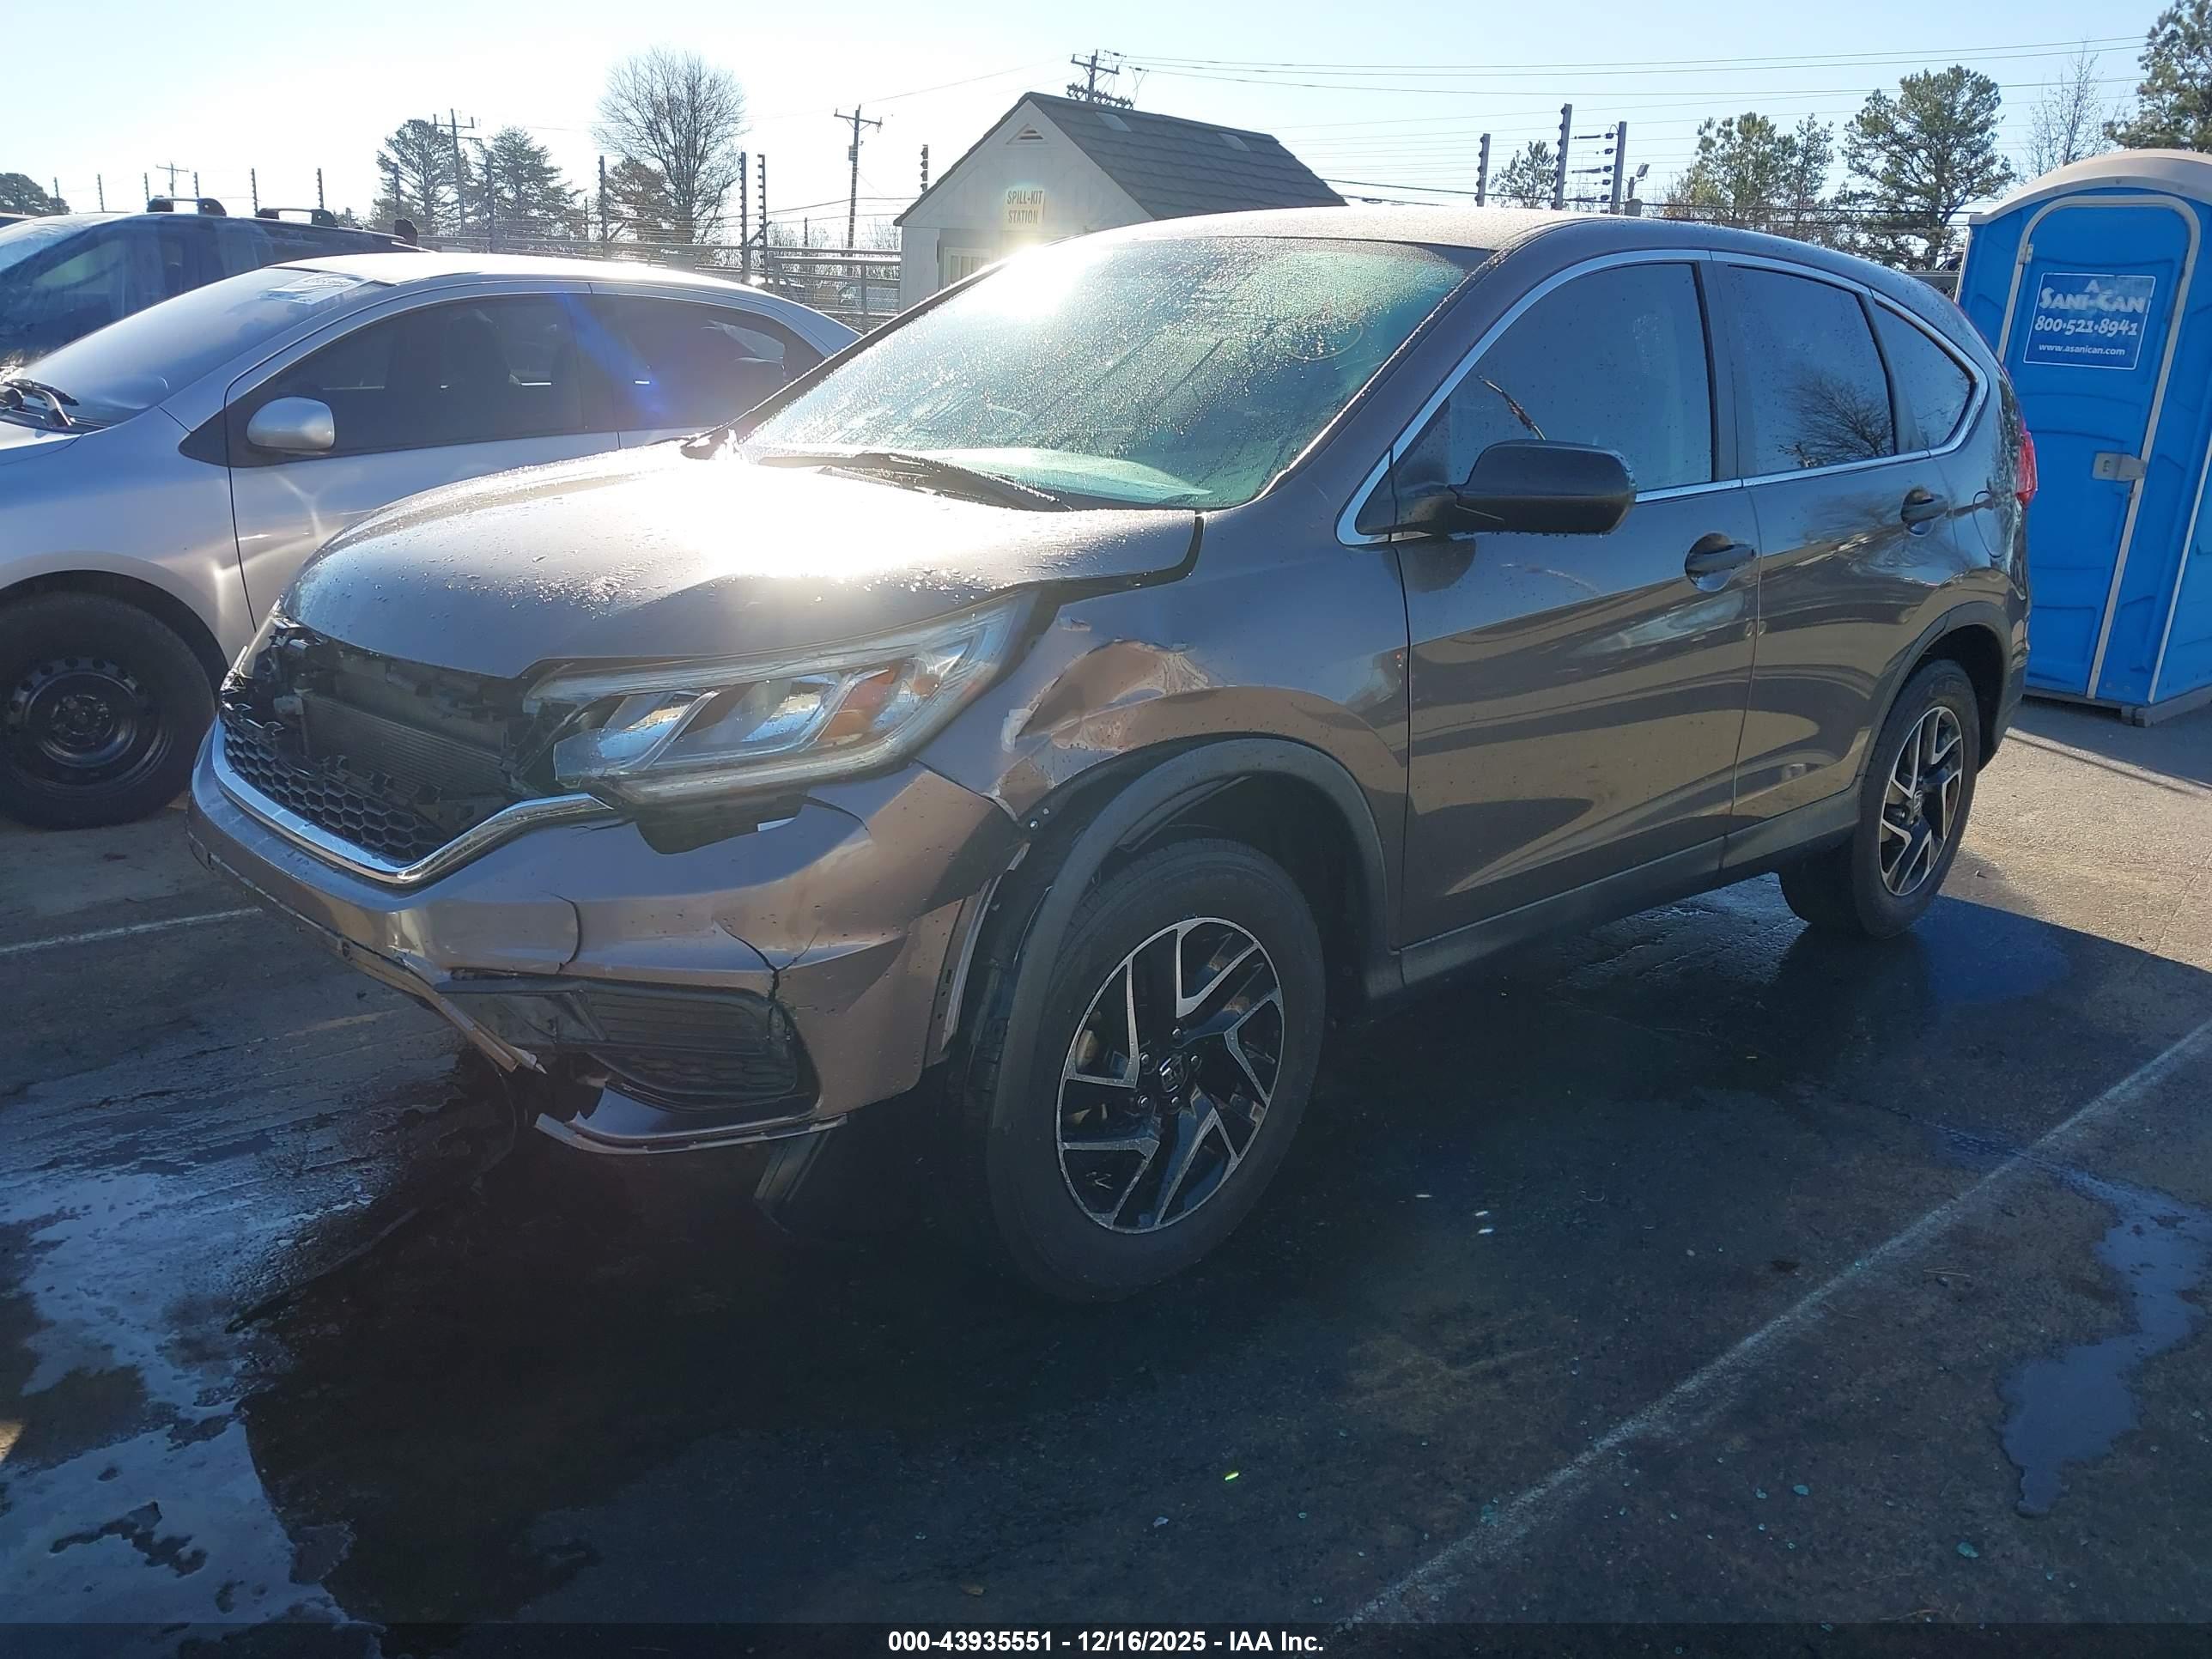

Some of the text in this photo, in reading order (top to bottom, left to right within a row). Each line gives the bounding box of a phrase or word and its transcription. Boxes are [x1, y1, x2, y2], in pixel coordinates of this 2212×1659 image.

[1007, 190, 1042, 204] SPILL-KIT
[1008, 210, 1039, 224] STATION
[2084, 279, 2100, 293] A
[2039, 344, 2125, 356] www.asanican.com
